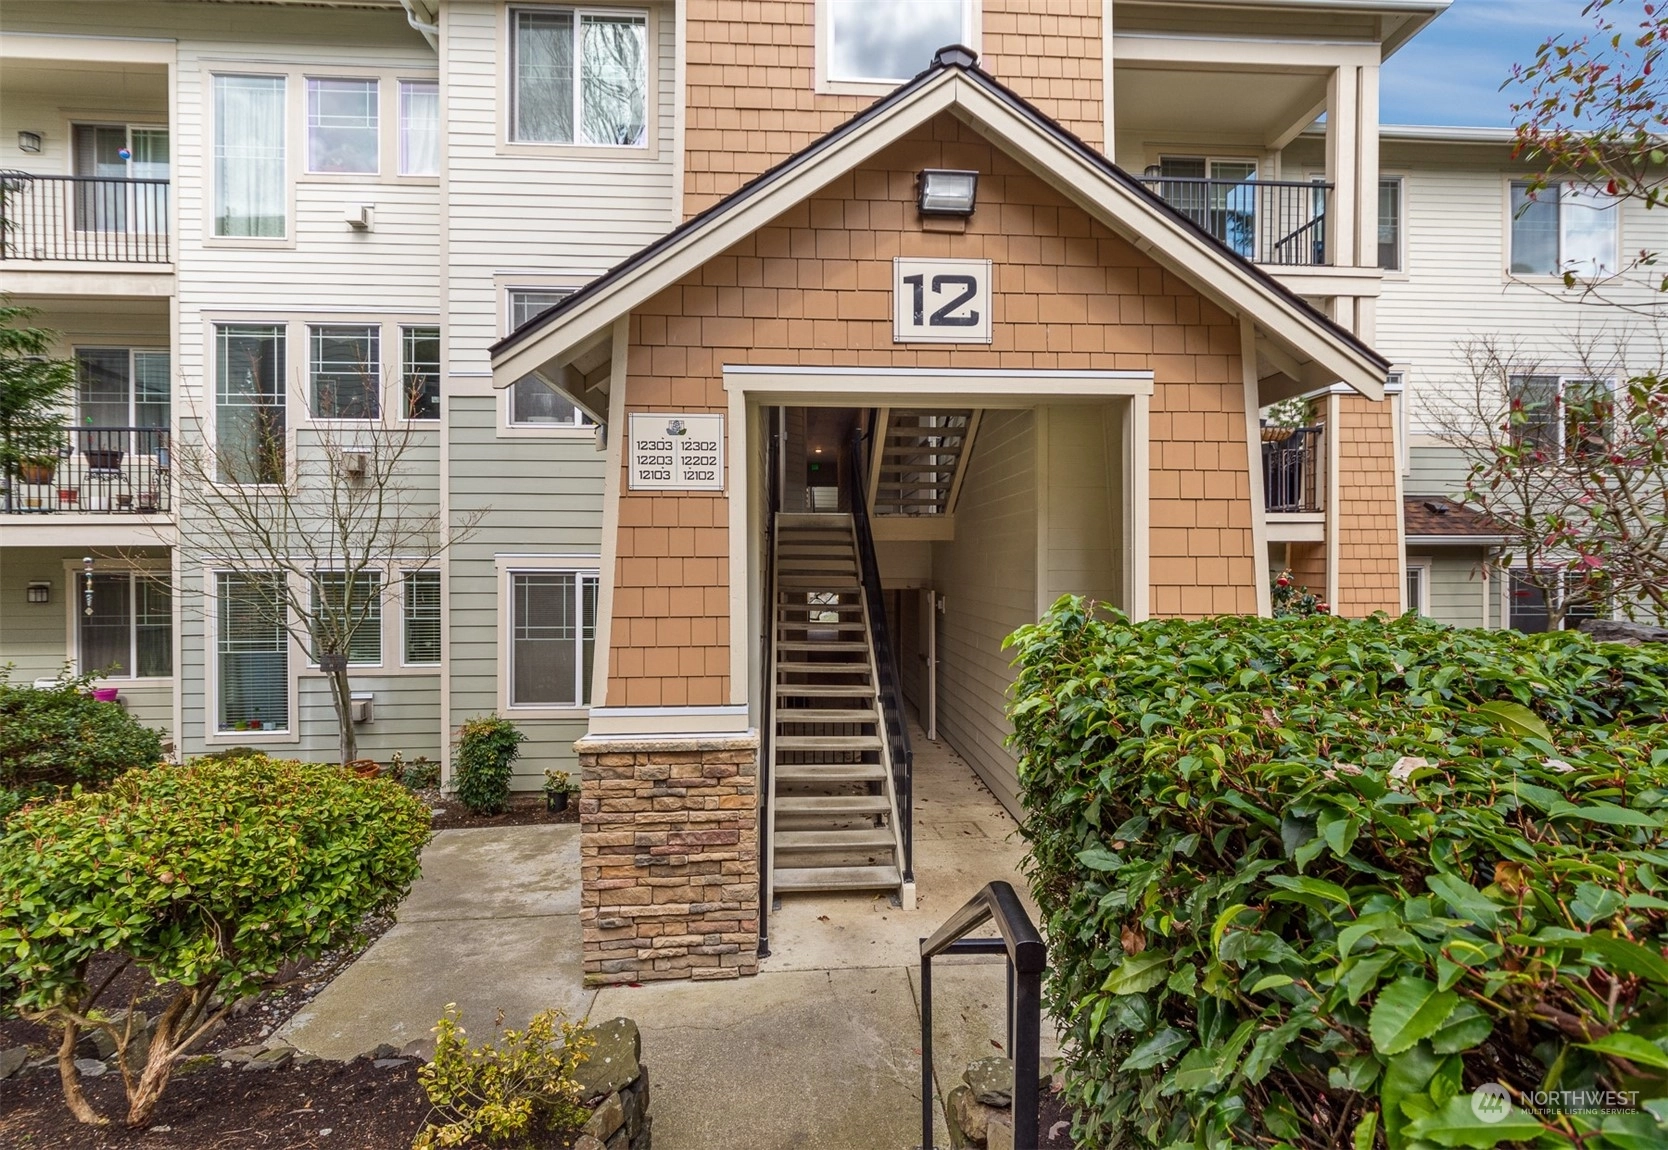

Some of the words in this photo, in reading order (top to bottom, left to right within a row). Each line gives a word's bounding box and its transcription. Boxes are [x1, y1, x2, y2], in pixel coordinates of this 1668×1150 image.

[903, 274, 979, 326] 12
[636, 440, 672, 450] 12303
[681, 442, 717, 451] 12302
[636, 456, 672, 465] 12203
[681, 456, 717, 466] 12202
[639, 470, 670, 480] 12103
[684, 471, 714, 480] 12102
